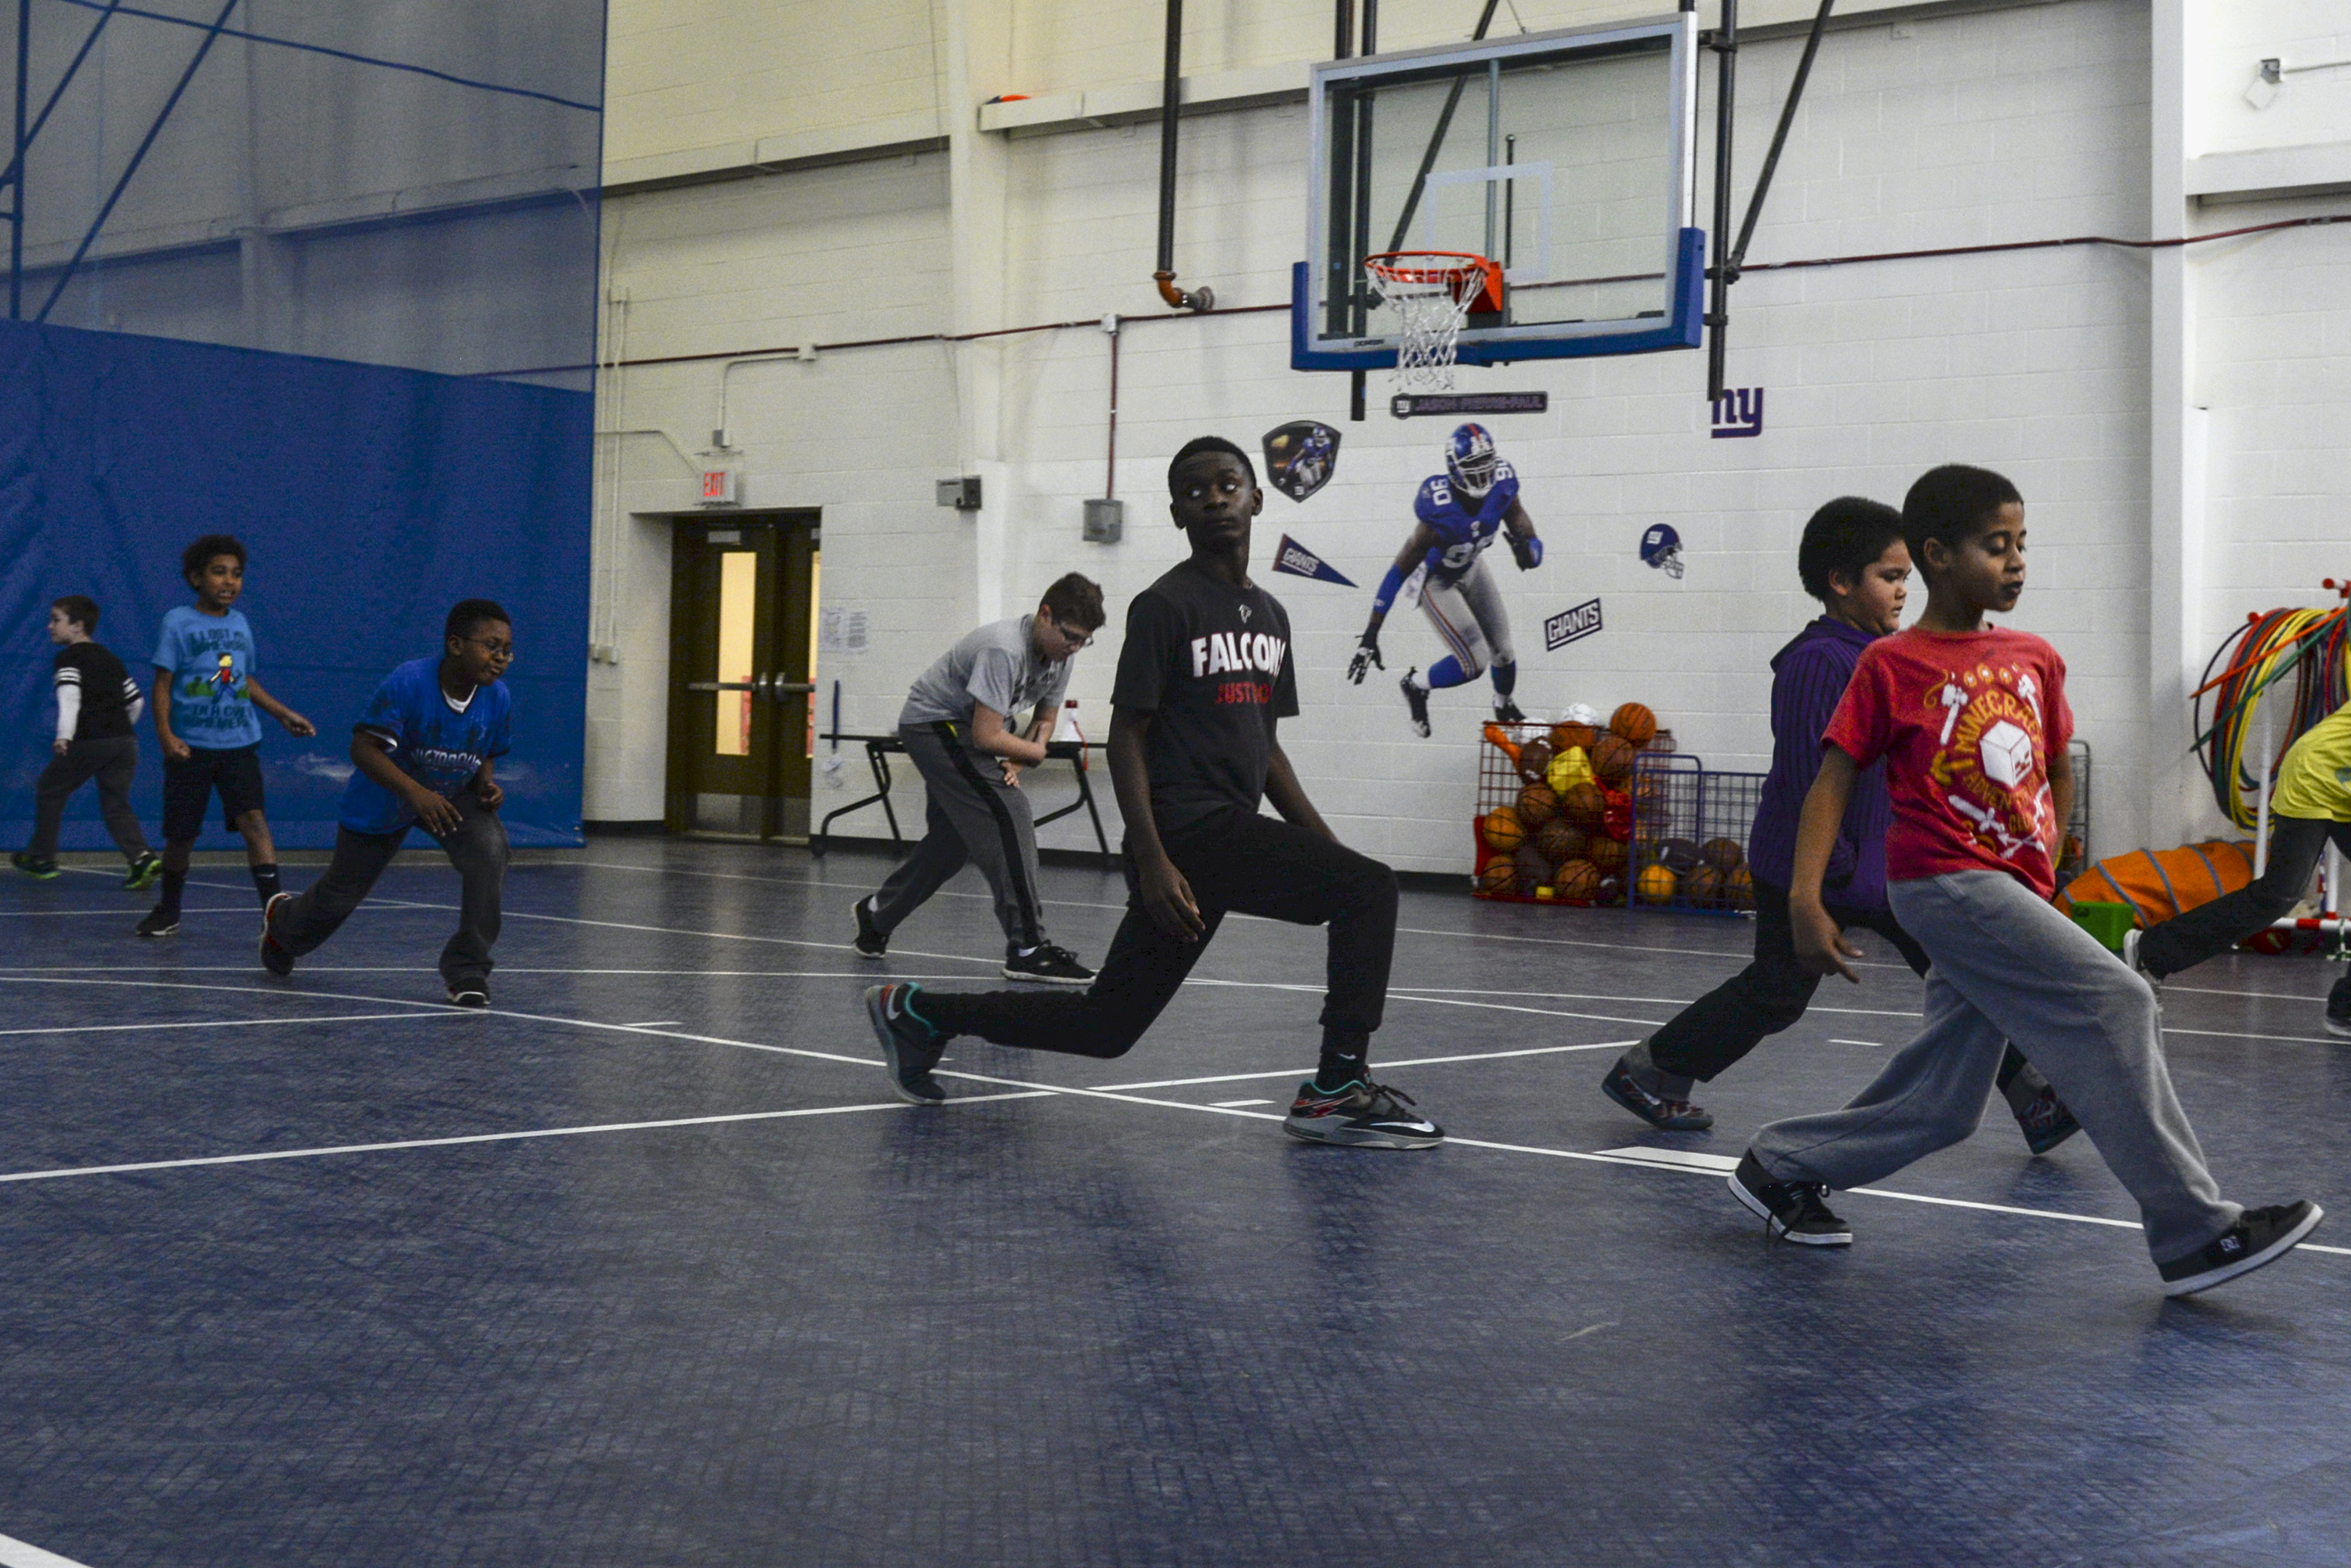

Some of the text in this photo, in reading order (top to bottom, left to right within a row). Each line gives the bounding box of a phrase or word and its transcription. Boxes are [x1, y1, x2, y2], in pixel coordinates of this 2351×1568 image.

[704, 472, 726, 497] EXIT
[1283, 548, 1320, 573] GIANTS
[1548, 602, 1599, 642] GIANTS
